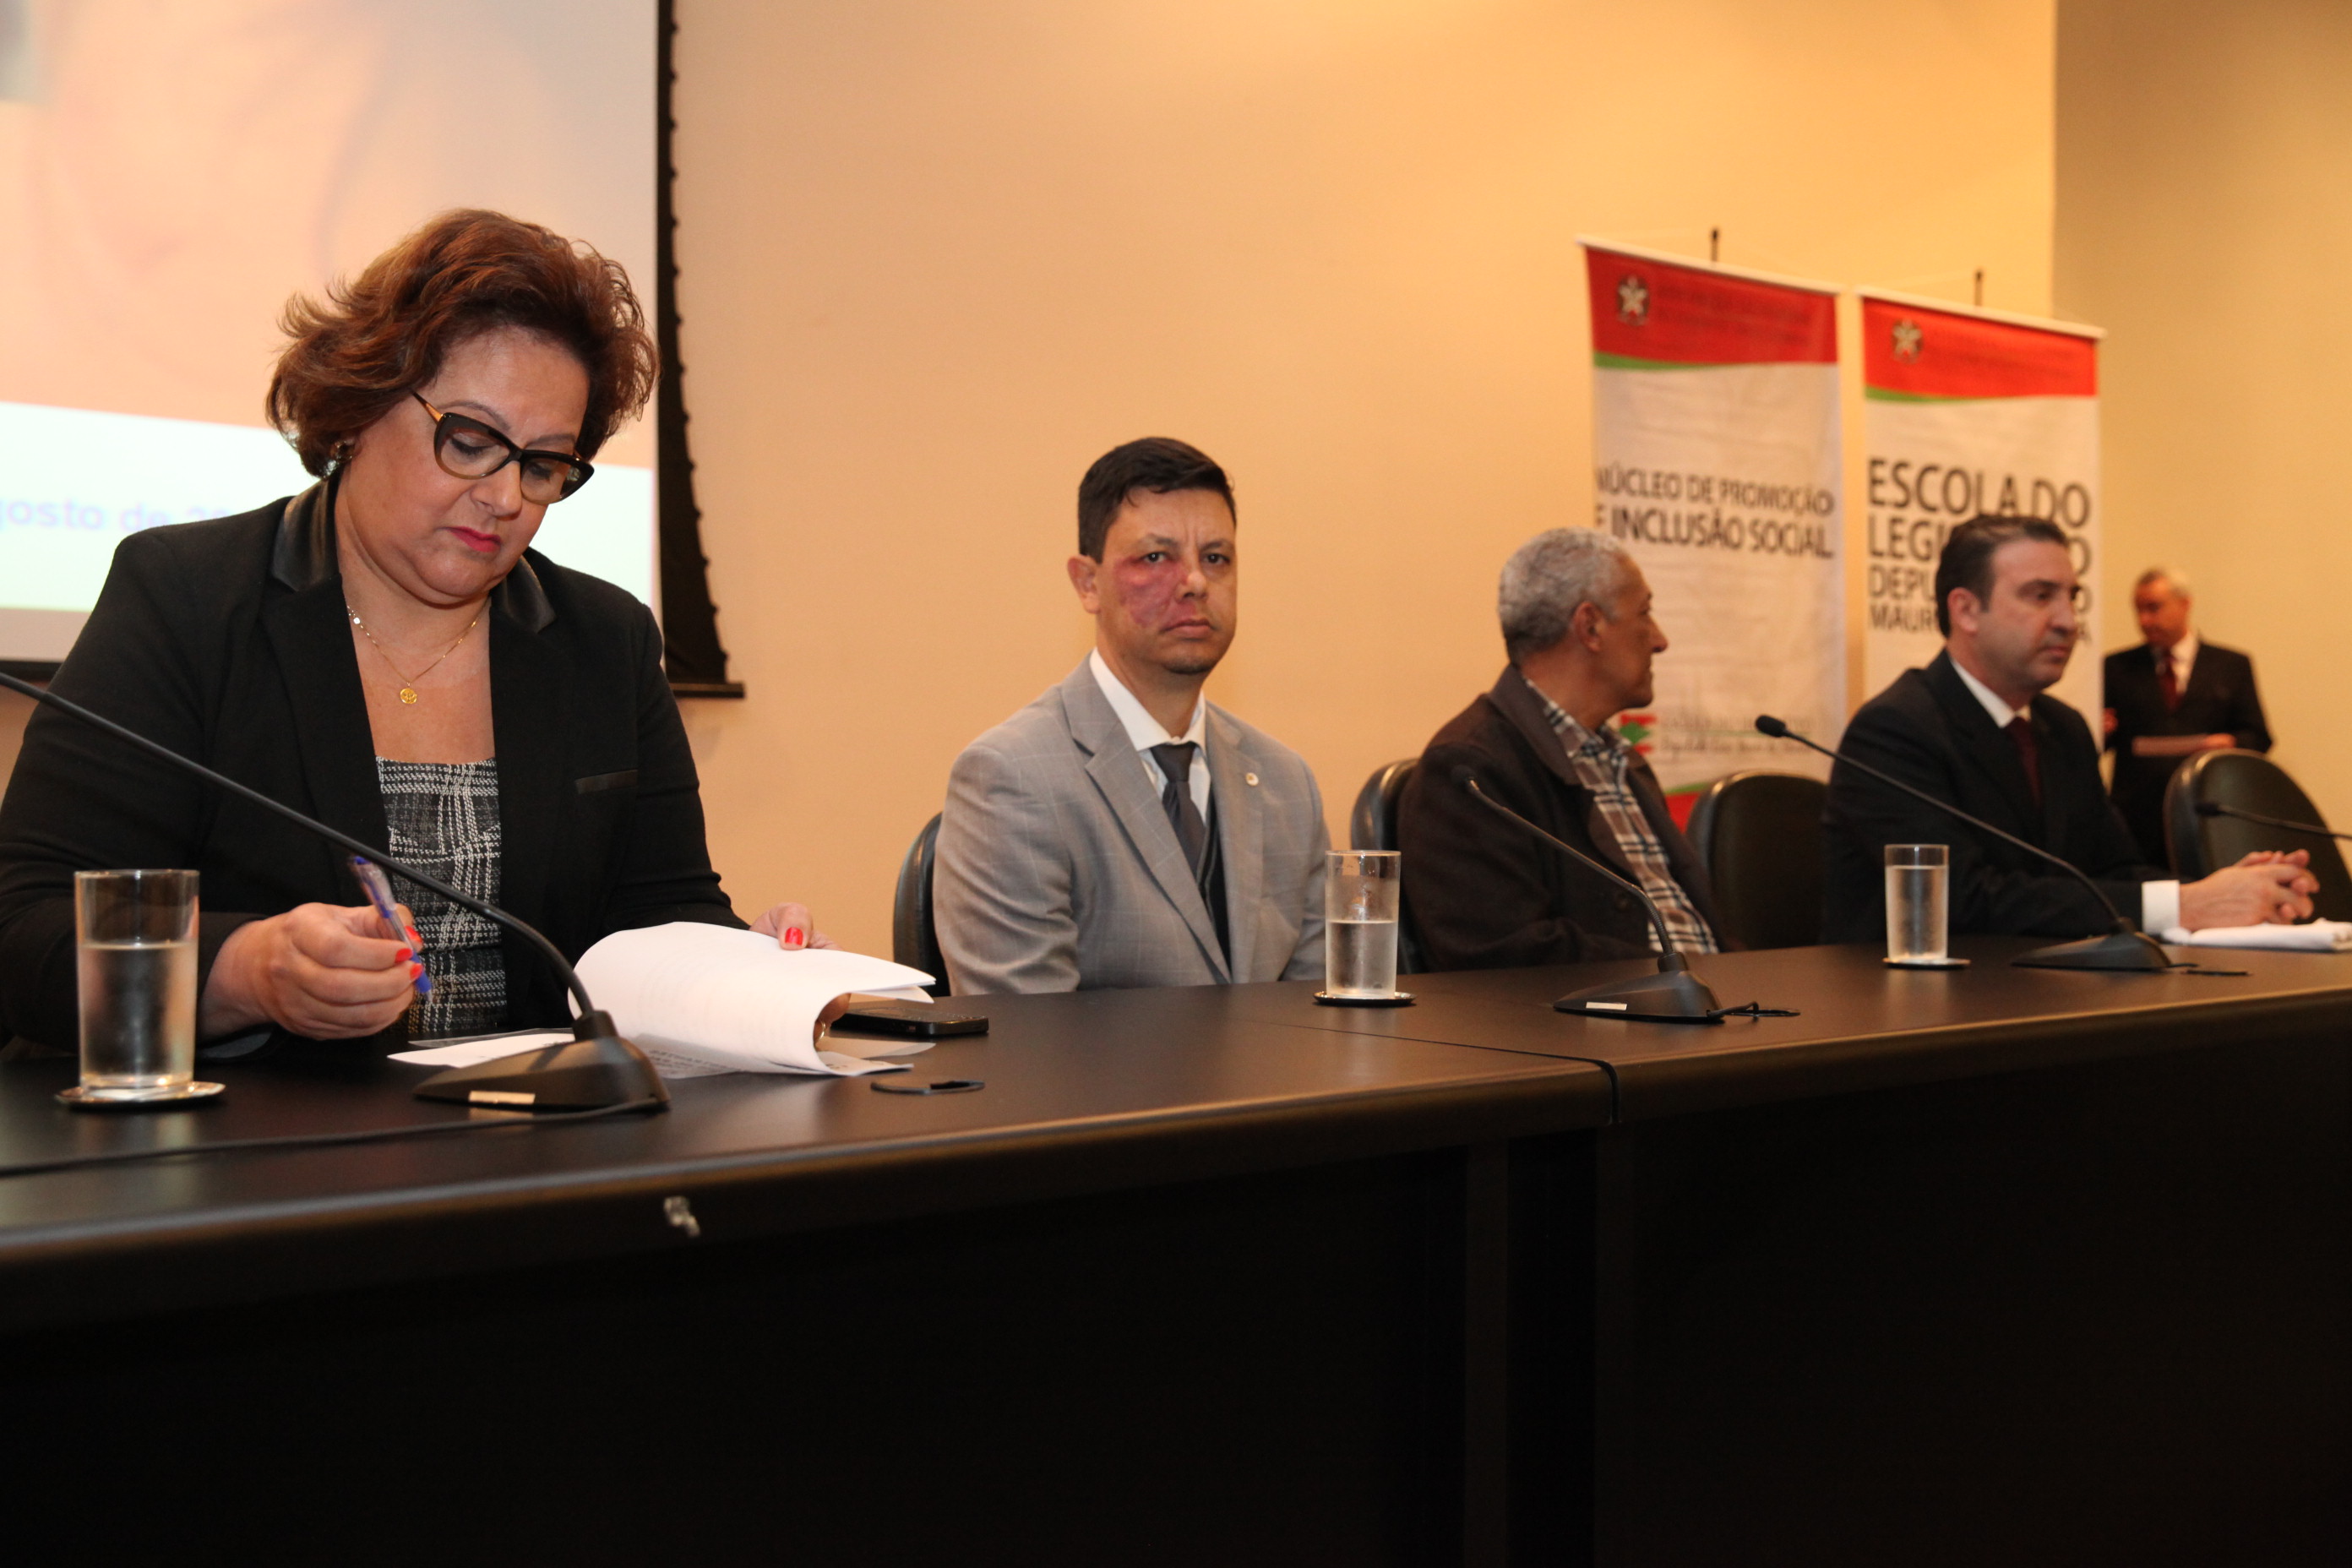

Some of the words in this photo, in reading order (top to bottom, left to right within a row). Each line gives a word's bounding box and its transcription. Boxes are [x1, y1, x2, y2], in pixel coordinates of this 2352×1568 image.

[0, 496, 104, 531] osto
[1687, 475, 1713, 504] DE
[1718, 478, 1835, 517] PROMOÇÃO
[1868, 459, 2020, 516] ESCOLA
[2032, 477, 2091, 528] DO
[1611, 506, 1745, 550] INCLUSÃO
[1749, 519, 1832, 558] SOCIAL
